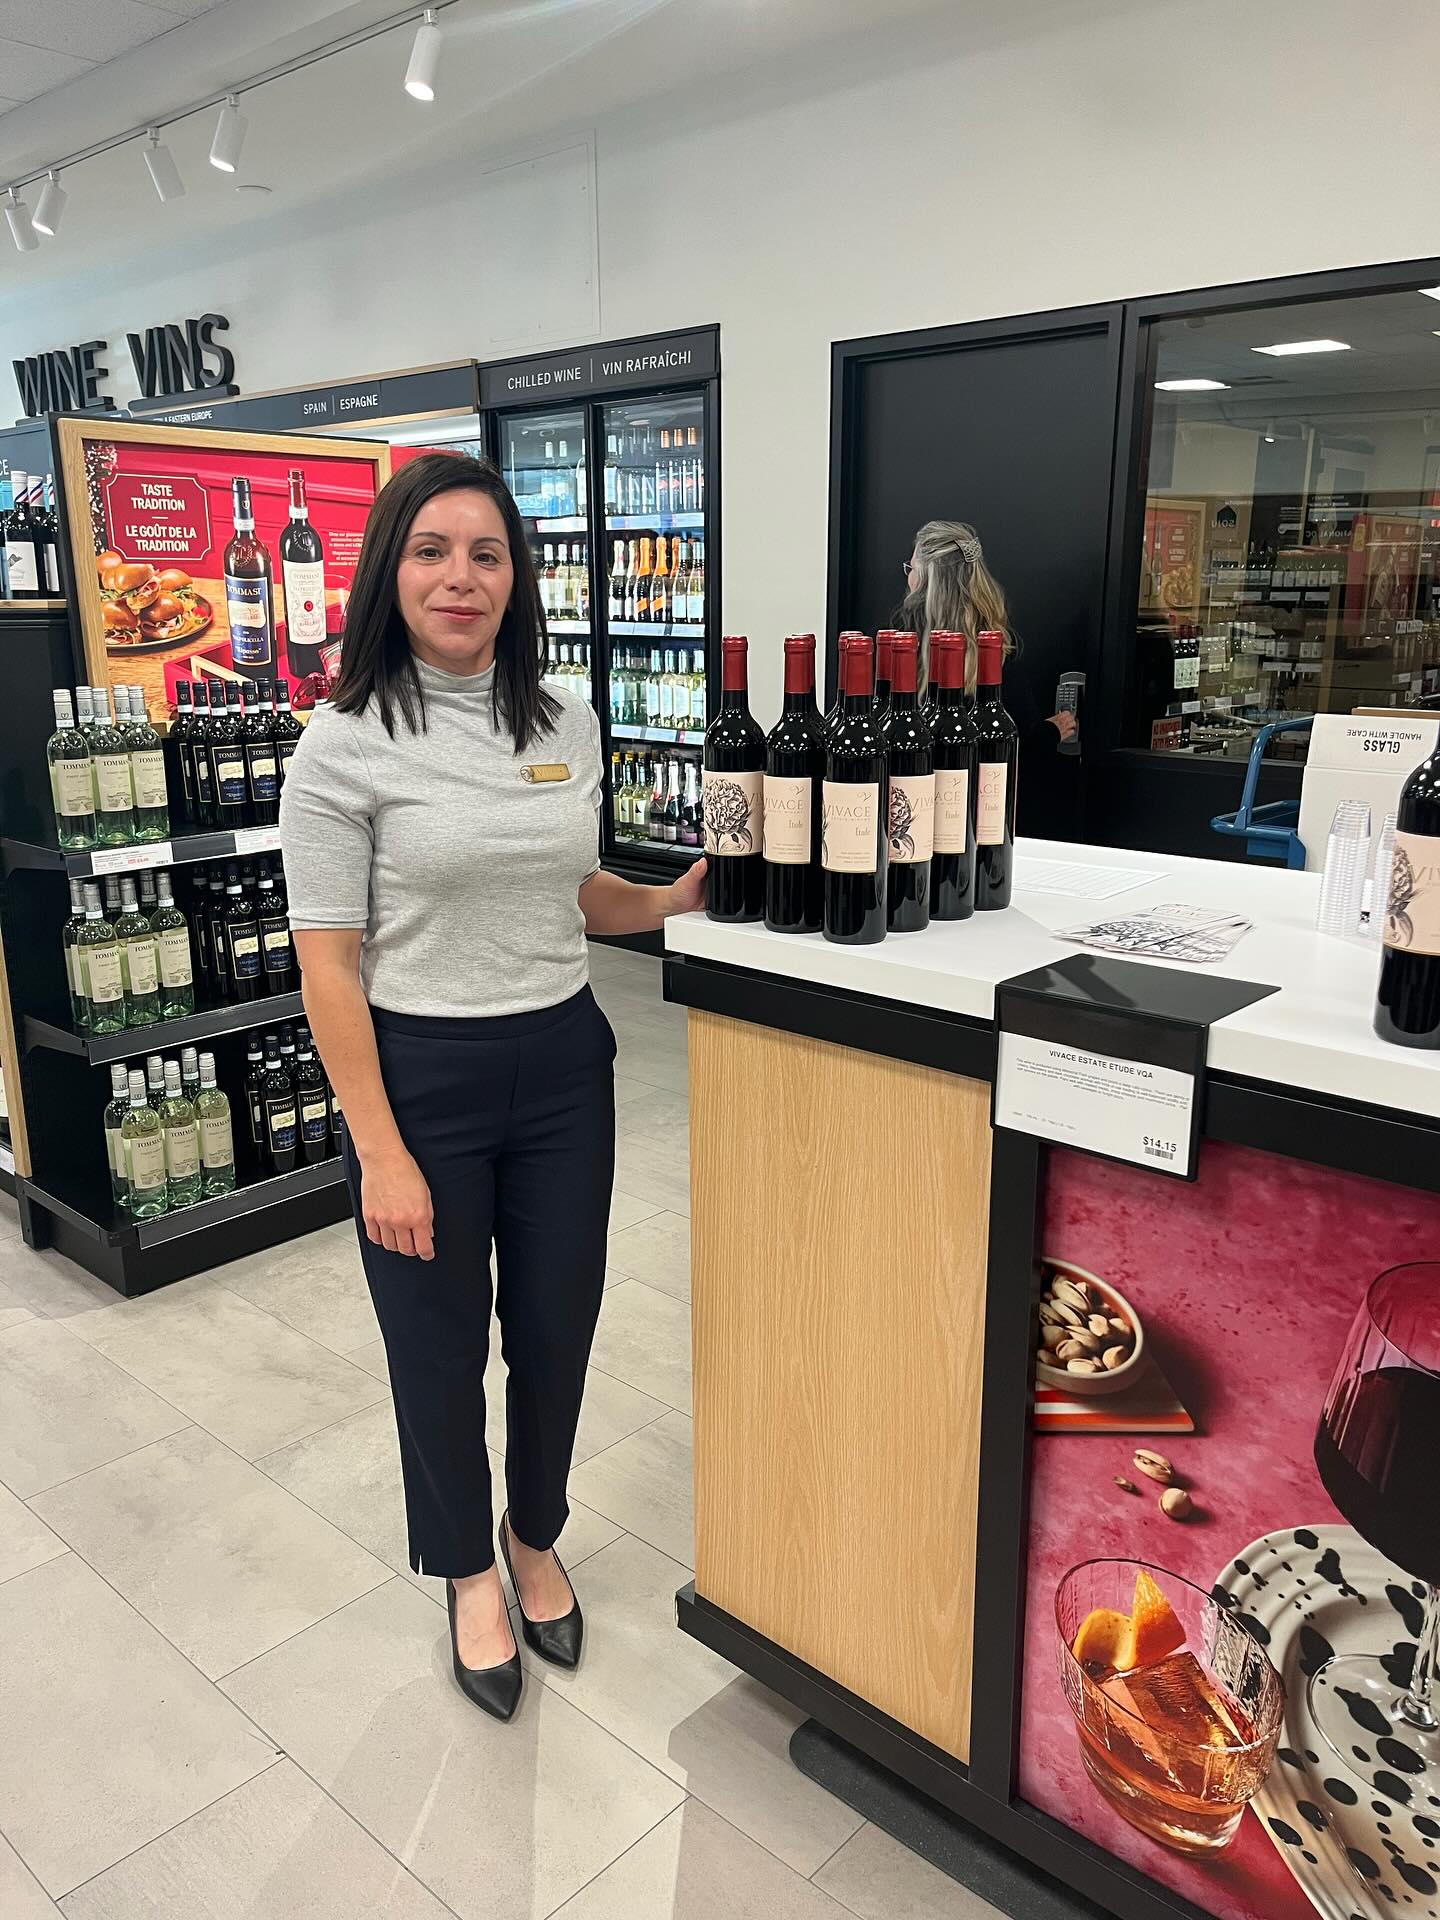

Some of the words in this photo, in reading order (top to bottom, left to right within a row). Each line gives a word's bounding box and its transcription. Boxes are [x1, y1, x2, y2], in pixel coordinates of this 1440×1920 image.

[12, 340, 109, 416] WINE
[126, 313, 235, 398] VINS
[602, 361, 622, 376] VIN
[626, 350, 691, 372] RAFRAÎCHI
[507, 372, 551, 390] CHILLED
[554, 367, 581, 383] WINE
[303, 401, 327, 415] SPAIN
[339, 394, 379, 410] ESPAGNE
[191, 410, 213, 421] EUROPE
[141, 483, 173, 496] TASTE
[130, 497, 186, 511] TRADITION
[125, 525, 139, 537] LE
[139, 523, 167, 538] GOÛT
[169, 527, 183, 538] DE
[184, 527, 197, 538] LA
[135, 539, 190, 552] TRADITION
[1346, 729, 1368, 737] CARE
[1369, 731, 1388, 739] WITH
[1390, 732, 1422, 740] HANDLE
[1363, 739, 1400, 754] GLASS
[1049, 1050, 1076, 1062] VIVACE
[1078, 1056, 1107, 1069] ESTATE
[1109, 1063, 1135, 1074] ETUDE
[1136, 1069, 1153, 1079] VQA
[1142, 1136, 1177, 1152] $14.15
